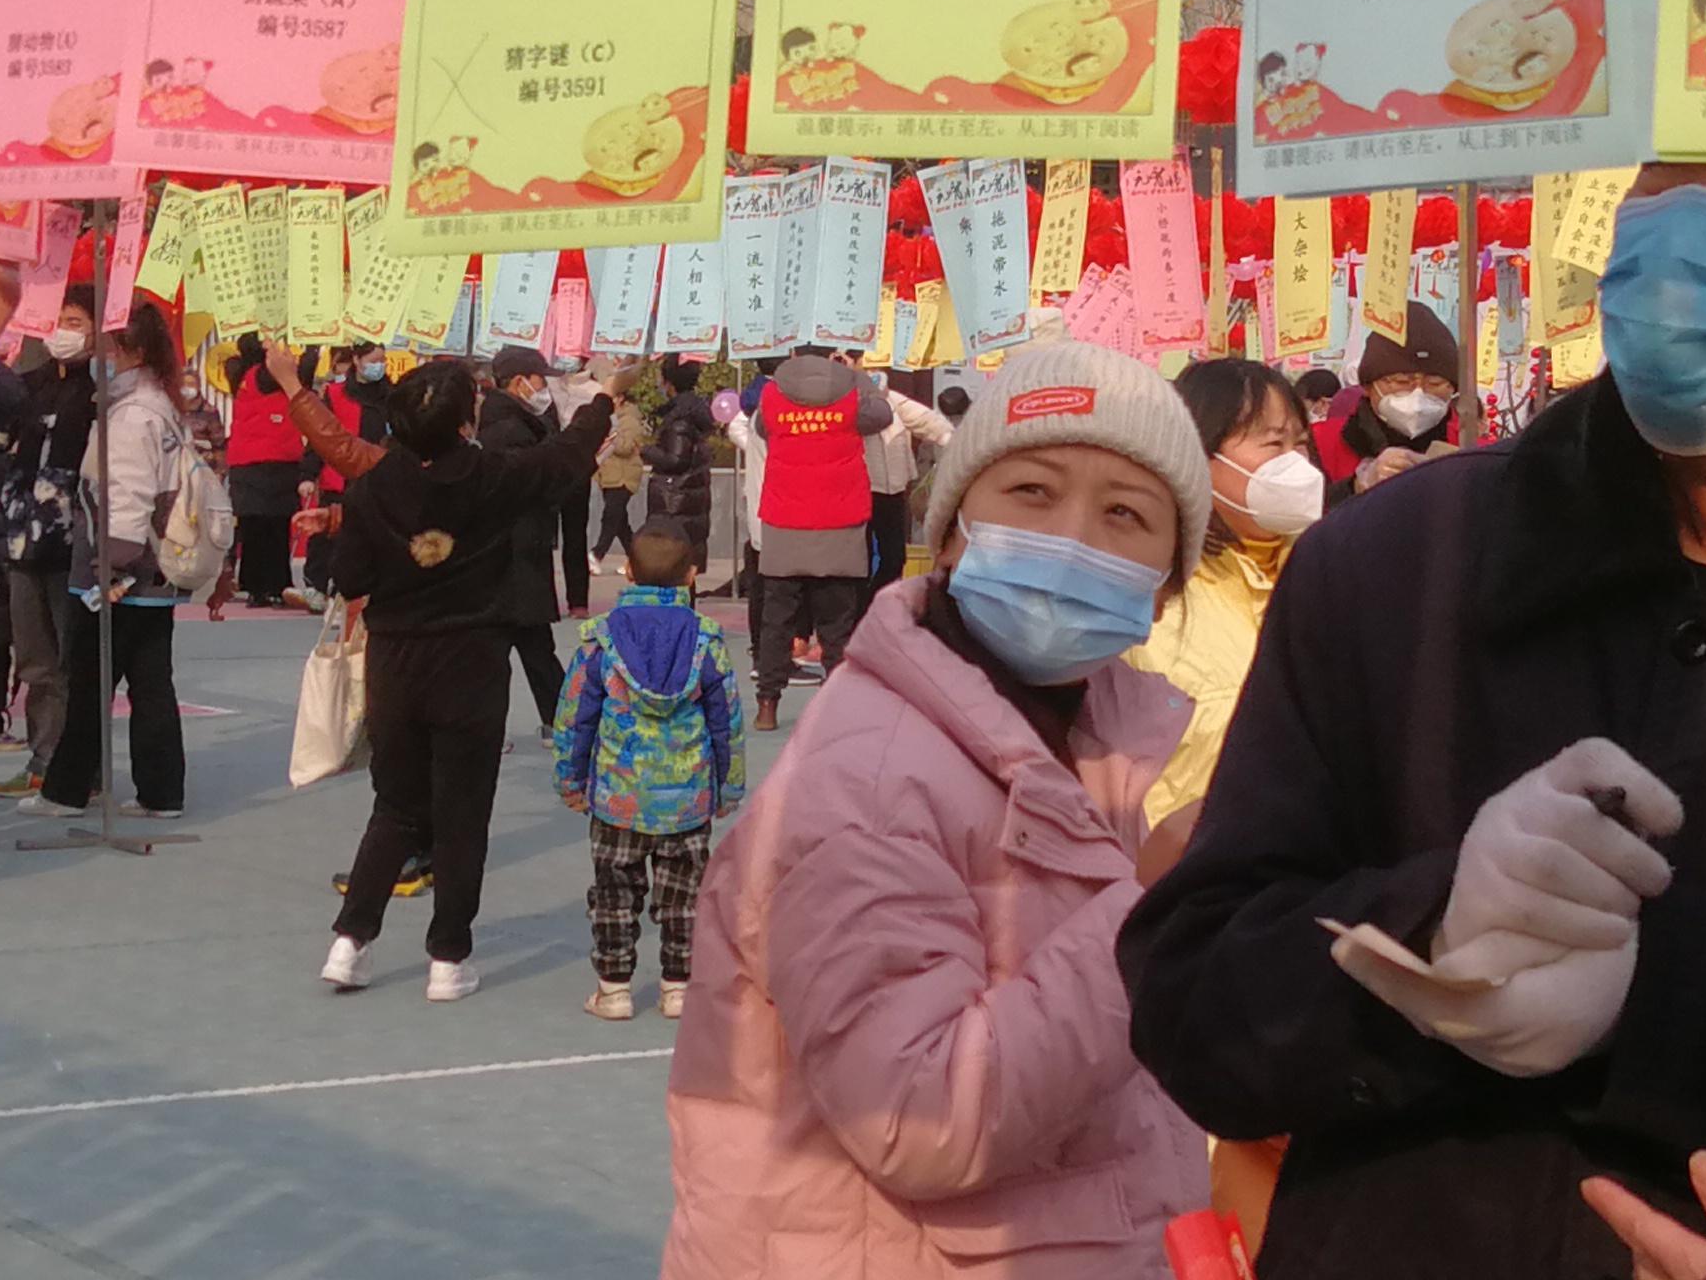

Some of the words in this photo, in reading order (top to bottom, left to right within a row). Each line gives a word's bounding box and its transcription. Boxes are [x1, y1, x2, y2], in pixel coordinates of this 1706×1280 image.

[257, 15, 348, 38] 编号3587
[519, 77, 606, 104] 编号3591
[746, 234, 765, 312] 一流水准
[991, 211, 1008, 297] 拖泥带水
